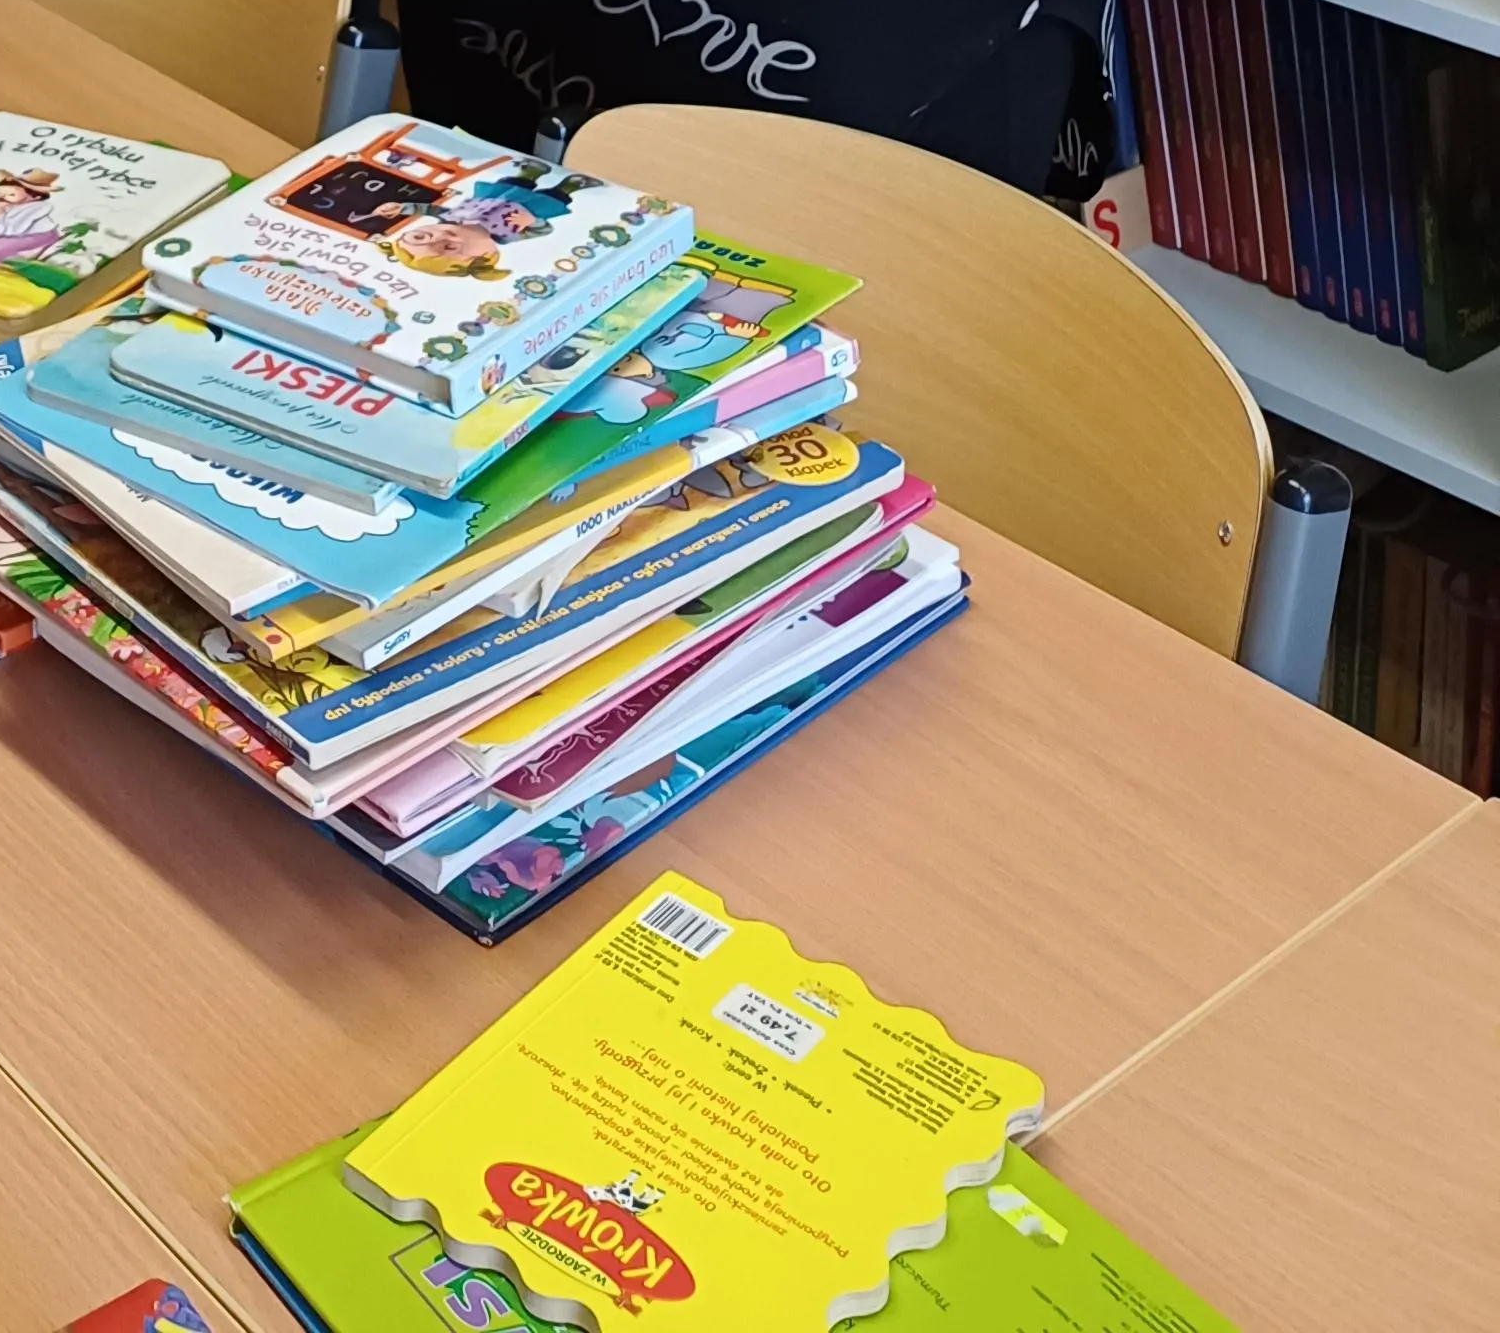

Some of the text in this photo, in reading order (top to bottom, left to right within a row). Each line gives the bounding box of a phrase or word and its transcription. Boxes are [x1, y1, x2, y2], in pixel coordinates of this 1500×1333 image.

[30, 125, 145, 164] O rybaku
[87, 164, 158, 190] rybce
[1093, 198, 1120, 250] S
[253, 231, 421, 300] Liza bawi się
[338, 239, 359, 253] w
[238, 263, 373, 321] dziewczynka
[231, 348, 396, 417] PIESKI
[767, 438, 829, 467] 30
[784, 456, 846, 478] klapek
[576, 511, 604, 539] 1000
[323, 702, 349, 723] dni
[350, 672, 426, 710] tygodnia
[430, 644, 484, 675] kolory
[569, 581, 625, 613] miejsca
[632, 556, 674, 581] cyfry
[679, 521, 742, 559] warzywa
[749, 498, 792, 524] owoce
[678, 1016, 713, 1043] Kotek
[759, 1014, 798, 1041] 7,49
[674, 1068, 686, 1080] o
[592, 1037, 832, 1194] Oto mała krówka jej przygody.
[688, 1076, 741, 1116] historii
[741, 1109, 821, 1165] Posłuchaj
[510, 1169, 674, 1289] Krówka
[590, 1273, 607, 1287] W
